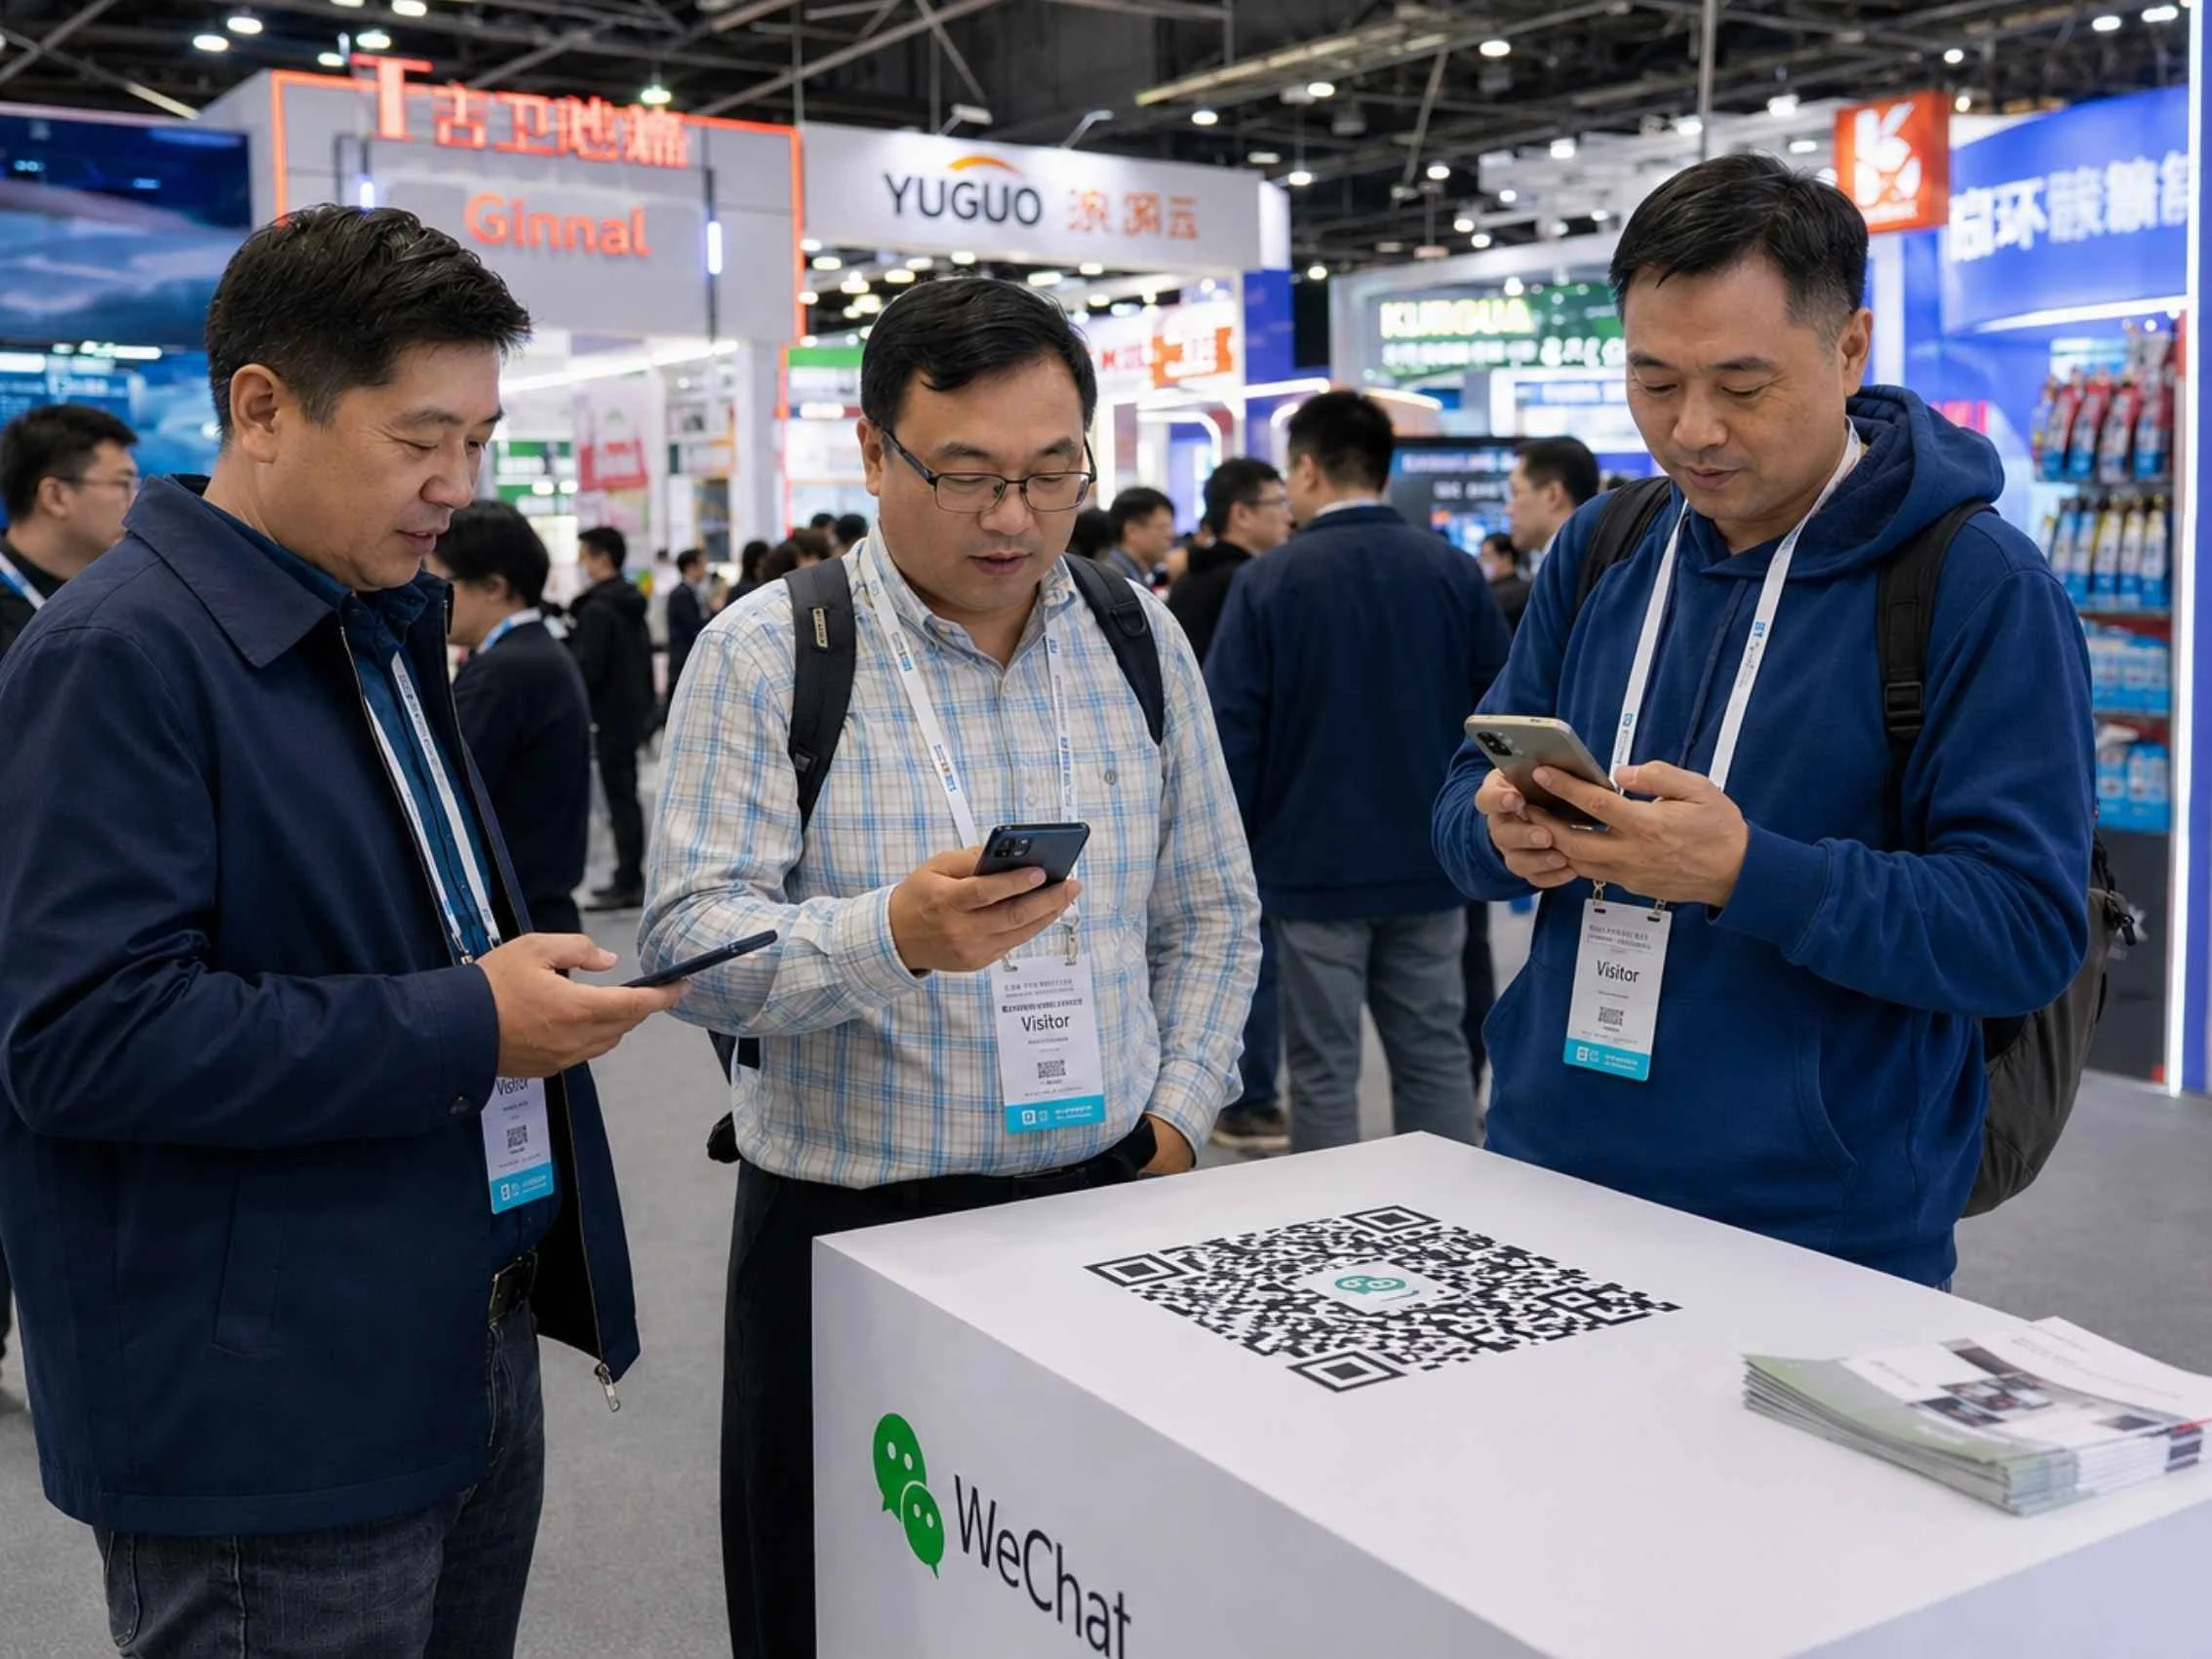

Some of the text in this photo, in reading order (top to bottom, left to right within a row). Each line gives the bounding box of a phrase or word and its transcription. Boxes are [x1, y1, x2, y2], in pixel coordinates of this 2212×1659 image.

[463, 192, 651, 257] Ginnal
[884, 172, 1043, 226] YUGUO
[1597, 960, 1640, 983] Visitor
[1020, 1014, 1070, 1032] Visitor
[954, 1474, 1131, 1659] WeChat
